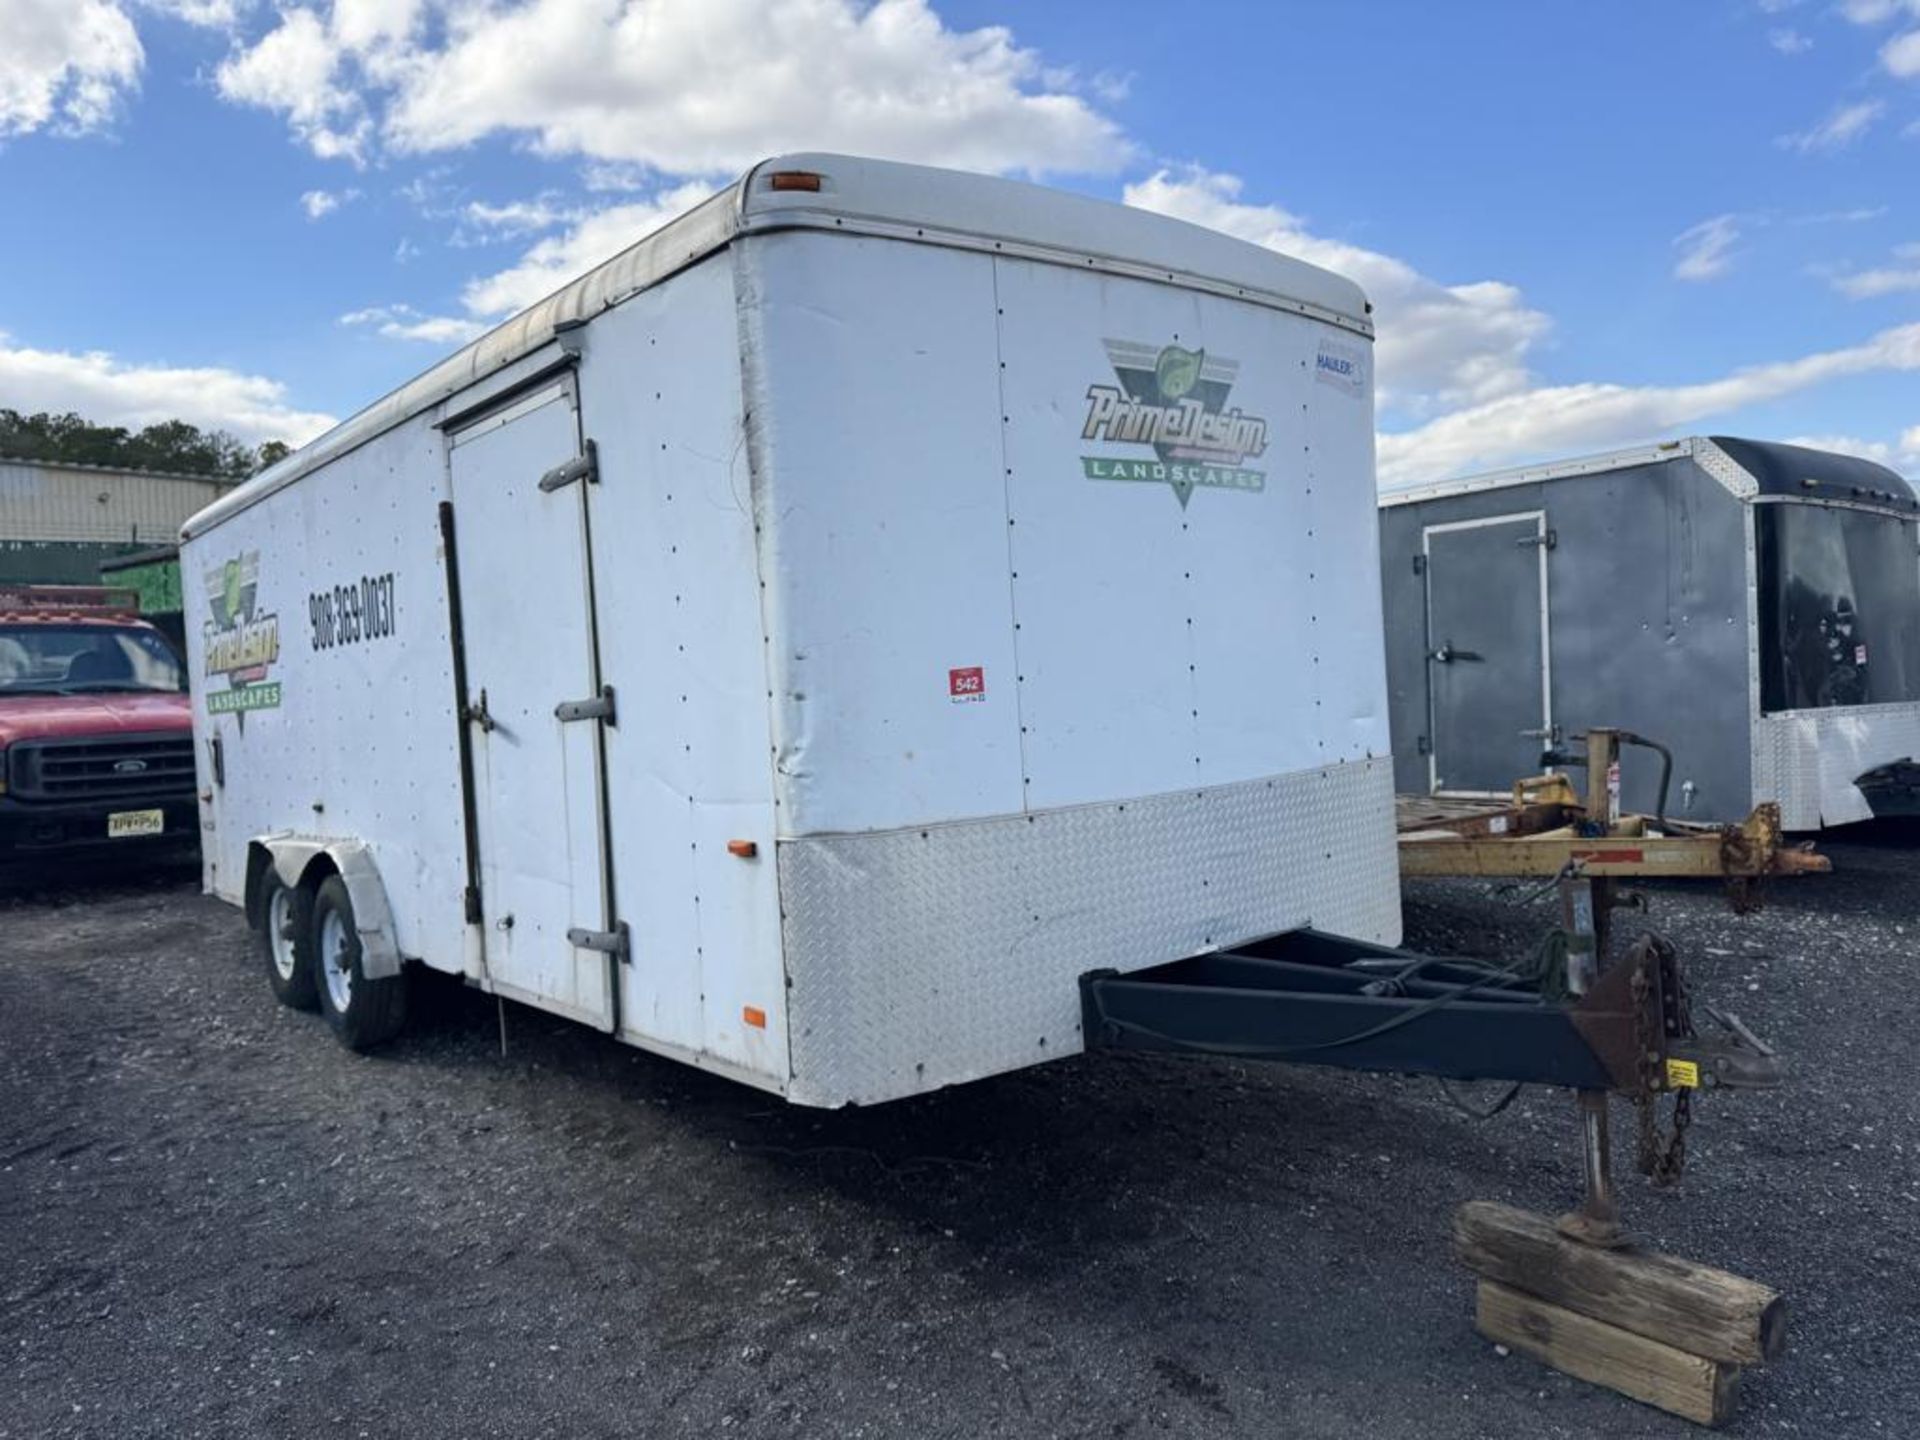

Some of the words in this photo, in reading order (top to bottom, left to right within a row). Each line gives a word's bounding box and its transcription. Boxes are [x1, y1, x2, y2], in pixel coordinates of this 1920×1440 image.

[1090, 460, 1263, 489] LANDSCAPES
[308, 571, 396, 652] 908-369-0037
[955, 676, 979, 692] 542
[208, 685, 279, 713] LANDSCAPES
